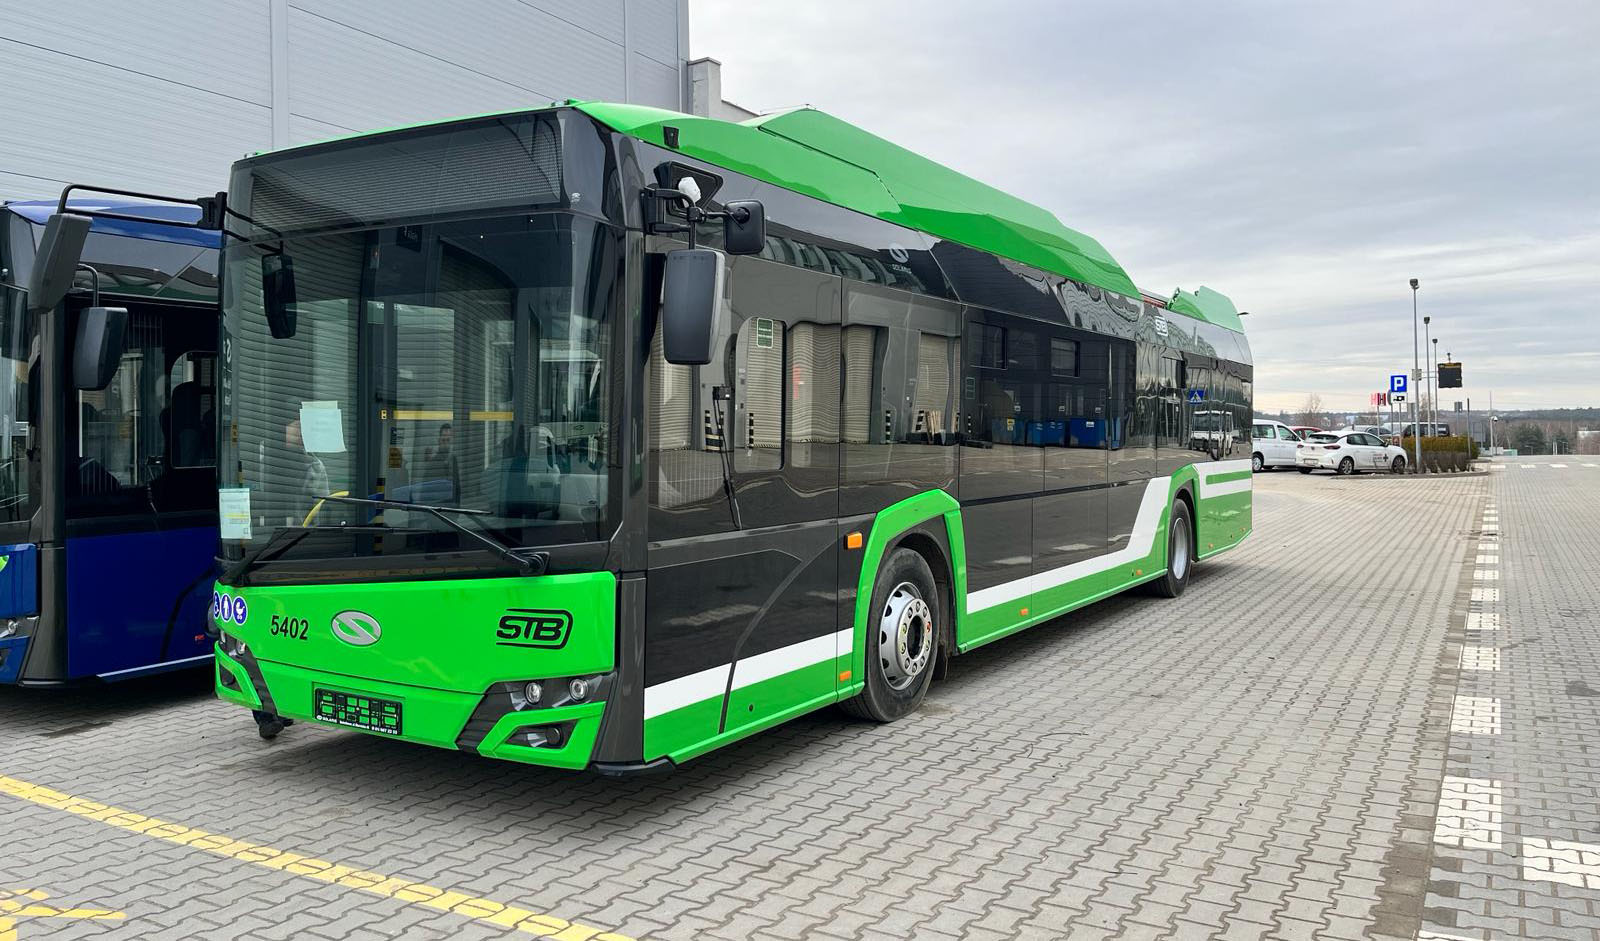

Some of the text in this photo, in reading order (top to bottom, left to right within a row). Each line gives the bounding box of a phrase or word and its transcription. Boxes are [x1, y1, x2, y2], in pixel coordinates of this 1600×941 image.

[1394, 377, 1404, 391] P
[270, 614, 309, 641] 5402
[496, 615, 565, 641] STB
